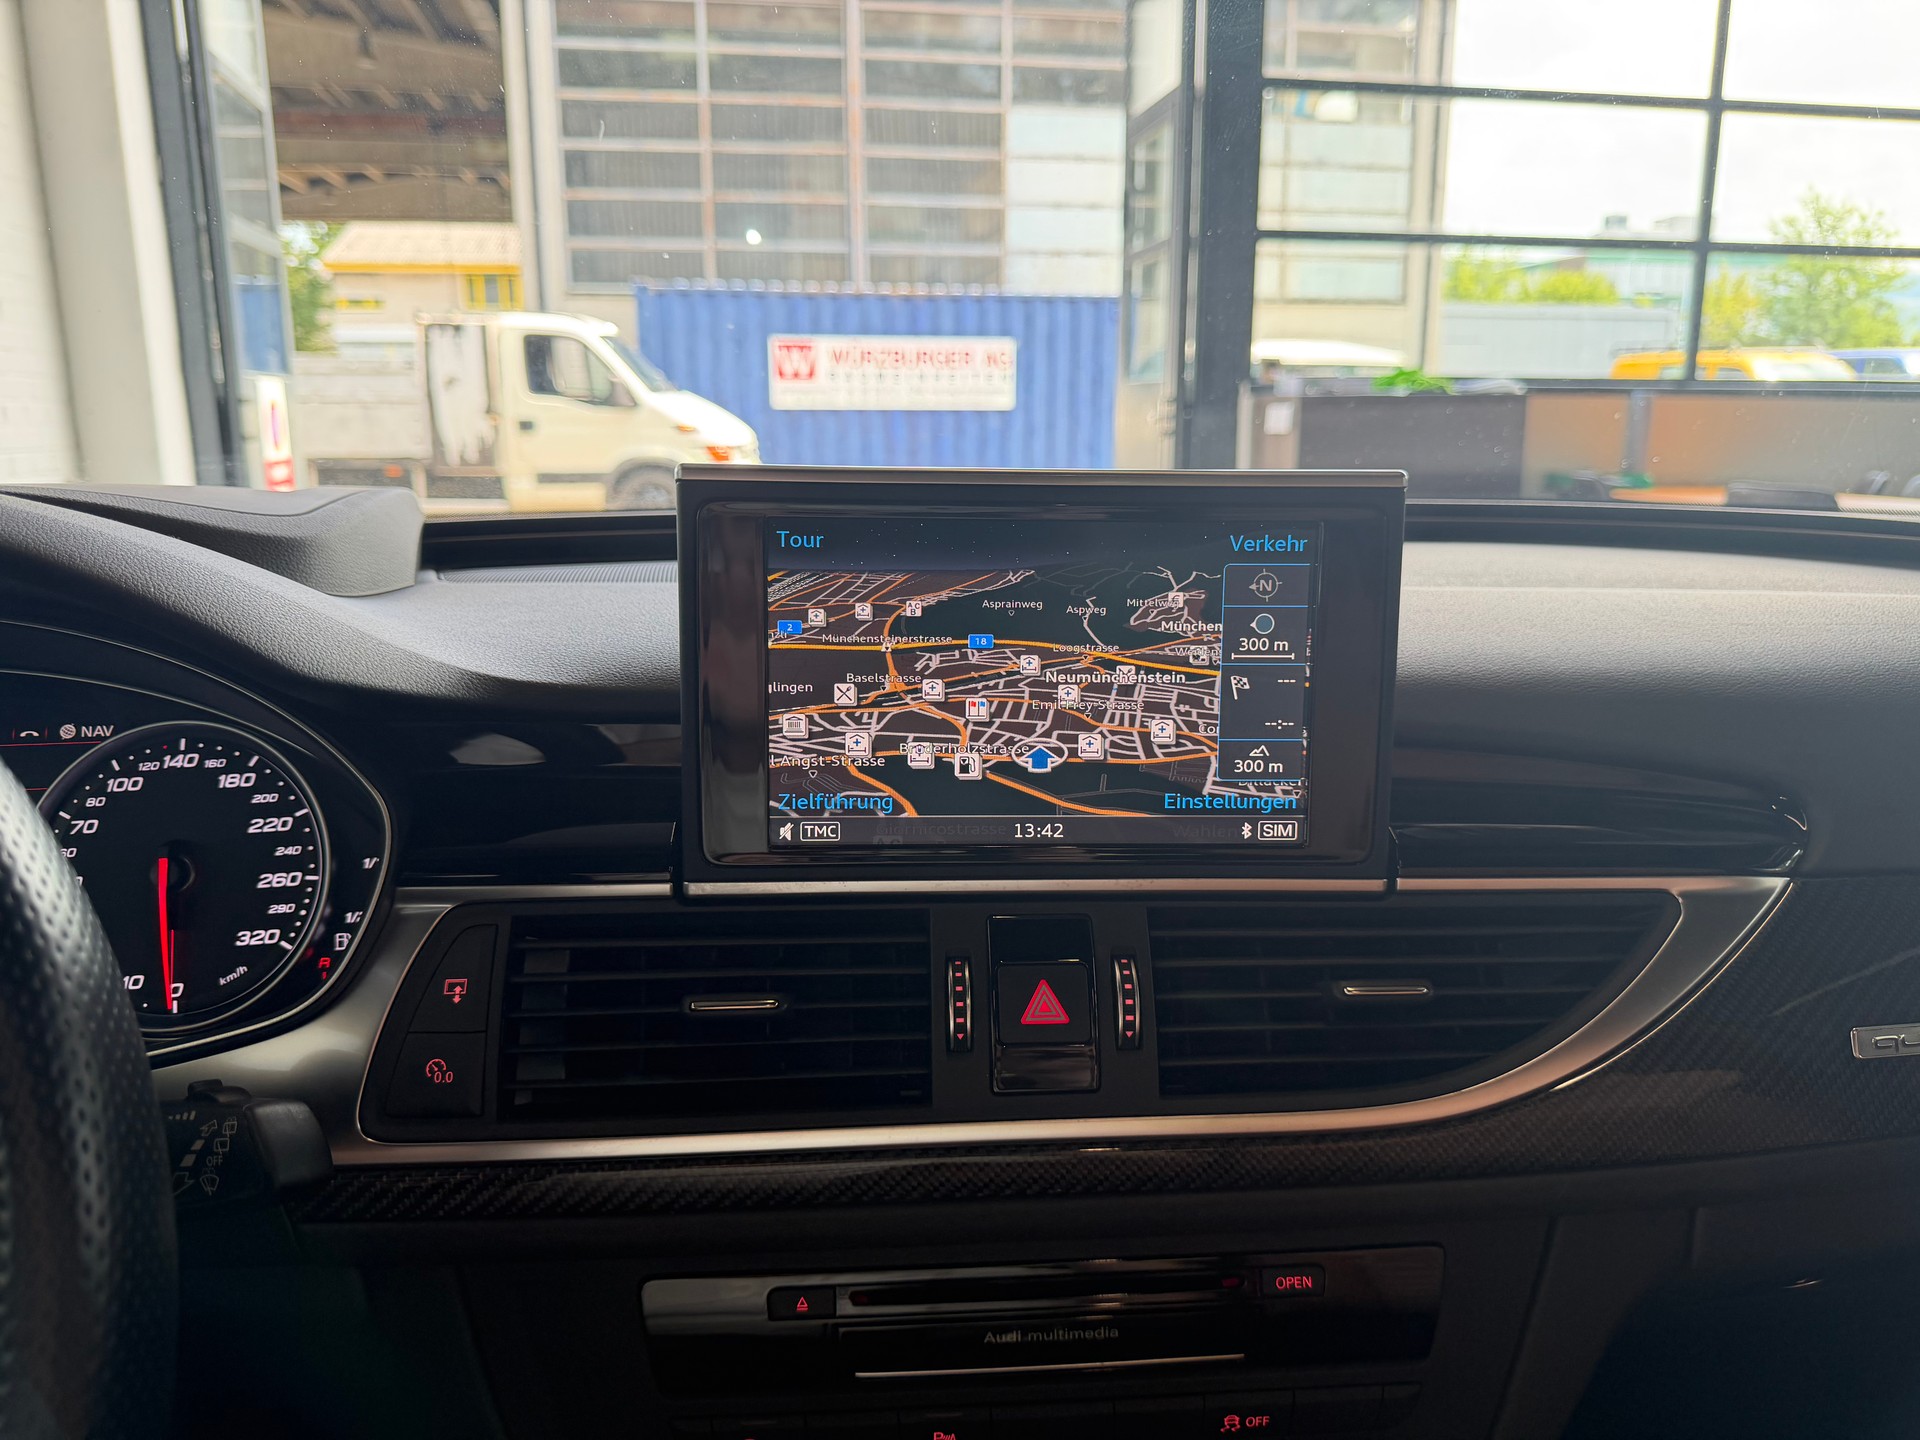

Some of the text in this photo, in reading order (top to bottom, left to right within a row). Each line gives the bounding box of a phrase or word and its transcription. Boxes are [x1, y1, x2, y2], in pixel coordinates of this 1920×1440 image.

[776, 530, 824, 549] Tour
[1229, 533, 1308, 553] Verkehr
[981, 600, 1044, 612] Asprainweg
[1066, 604, 1107, 617] Aspweg
[786, 623, 794, 632] 2
[1161, 620, 1222, 632] München
[821, 633, 953, 644] Münchensteinerstrasse
[973, 637, 988, 646] 18
[1239, 638, 1289, 651] 300 m
[1053, 642, 1120, 655] Loogstrasse
[846, 673, 923, 683] Baselstrasse
[1045, 671, 1186, 684] Neumünchenstein
[80, 725, 115, 738] NAV
[1198, 724, 1219, 735] Co
[138, 761, 160, 771] 120
[163, 753, 200, 769] 140
[203, 758, 227, 769] 160
[780, 755, 886, 769] Angst-Strasse
[1234, 760, 1284, 773] 300 m
[106, 777, 144, 793] 100
[217, 773, 257, 789] 180
[85, 797, 107, 808] 80
[251, 794, 280, 803] 200
[778, 793, 894, 814] Zielführung
[1163, 793, 1298, 814] Einstellungen
[69, 820, 99, 835] 70
[247, 816, 294, 834] 220
[804, 825, 838, 838] TMC
[1014, 823, 1064, 838] 13:42
[1262, 825, 1293, 838] SIM
[274, 846, 303, 856] 240
[256, 872, 303, 889] 260
[267, 903, 296, 914] 290
[234, 929, 281, 946] 320
[218, 964, 249, 987] km/h
[1275, 1274, 1313, 1291] OPEN
[984, 1327, 1120, 1344] Audi multimedia
[1246, 1416, 1271, 1428] OFF
